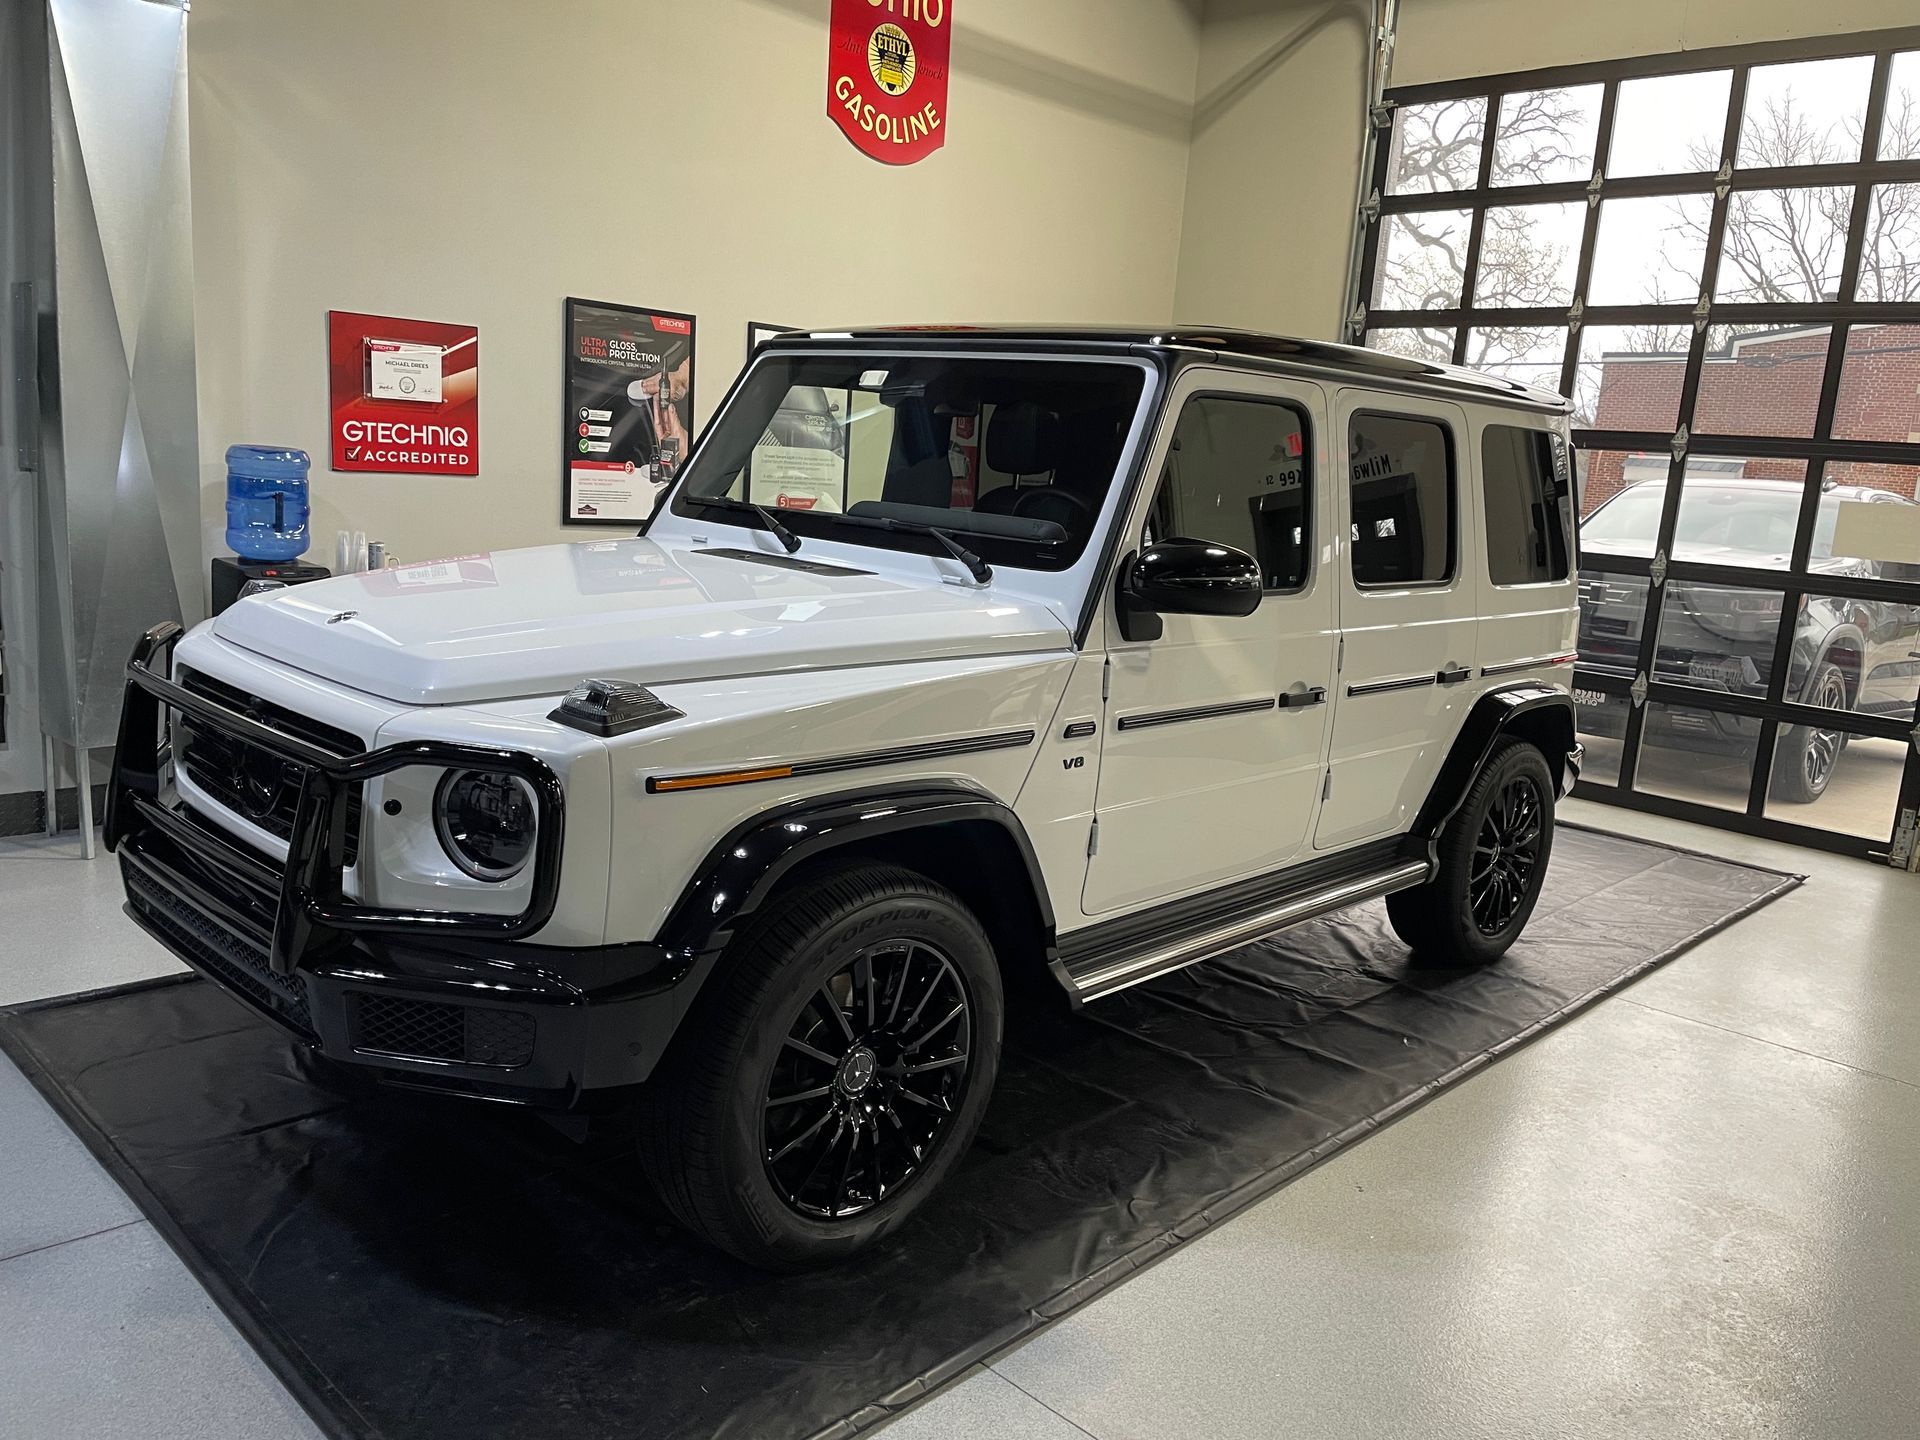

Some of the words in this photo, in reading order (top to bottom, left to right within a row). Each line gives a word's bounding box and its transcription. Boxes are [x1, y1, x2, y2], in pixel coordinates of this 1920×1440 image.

[877, 34, 908, 56] ETHYL
[835, 76, 941, 144] GASOLINE
[580, 336, 607, 348] ULTRA
[609, 339, 638, 353] GLOSS,
[385, 360, 409, 368] MICHAEL
[580, 346, 607, 358] ULTRA
[609, 349, 661, 364] PROTECTION
[342, 420, 469, 448] GTECHNIQ
[364, 449, 470, 466] ACCREDITED
[1062, 756, 1085, 770] V8
[811, 908, 931, 969] SCORPION
